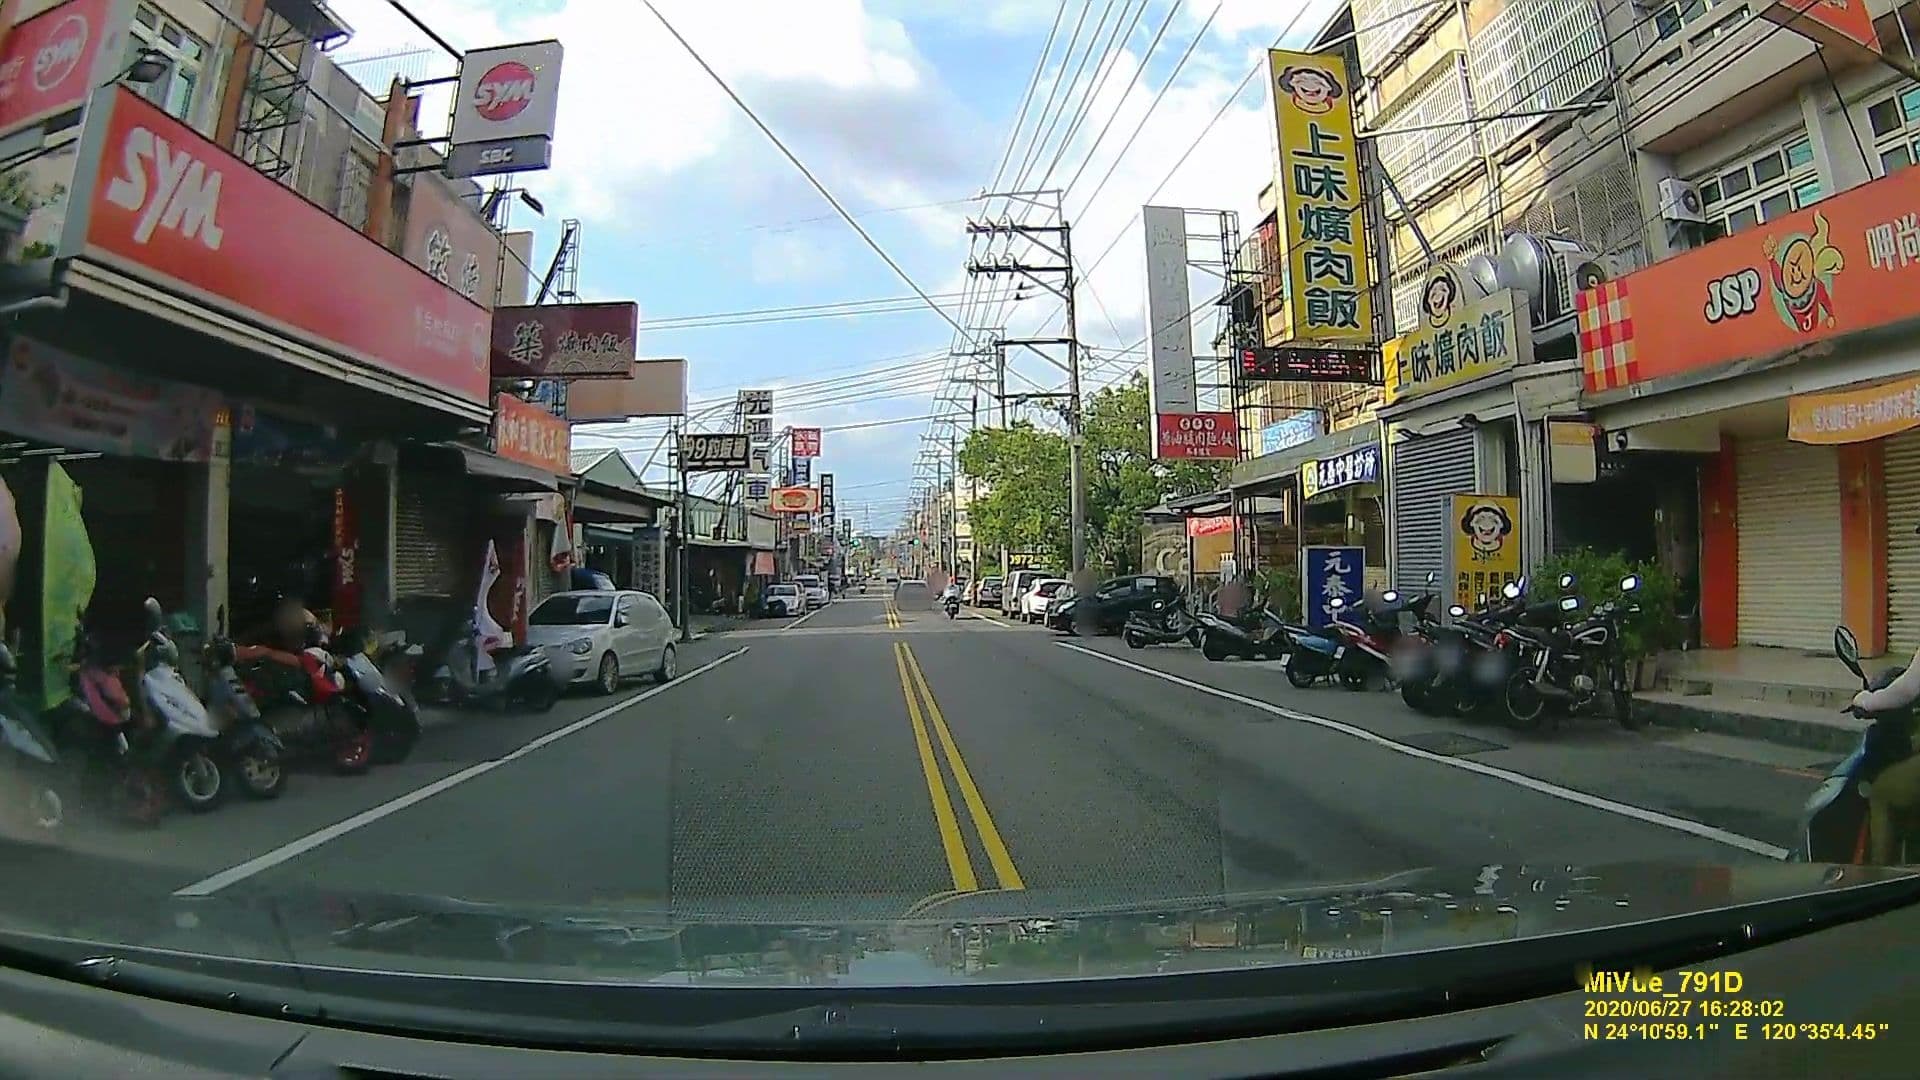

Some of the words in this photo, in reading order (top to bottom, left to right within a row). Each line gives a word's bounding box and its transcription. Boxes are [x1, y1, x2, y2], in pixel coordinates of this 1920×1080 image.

[34, 37, 84, 75] SYM
[473, 79, 534, 111] SYM
[107, 126, 224, 250] SYM
[1704, 268, 1762, 323] JSP
